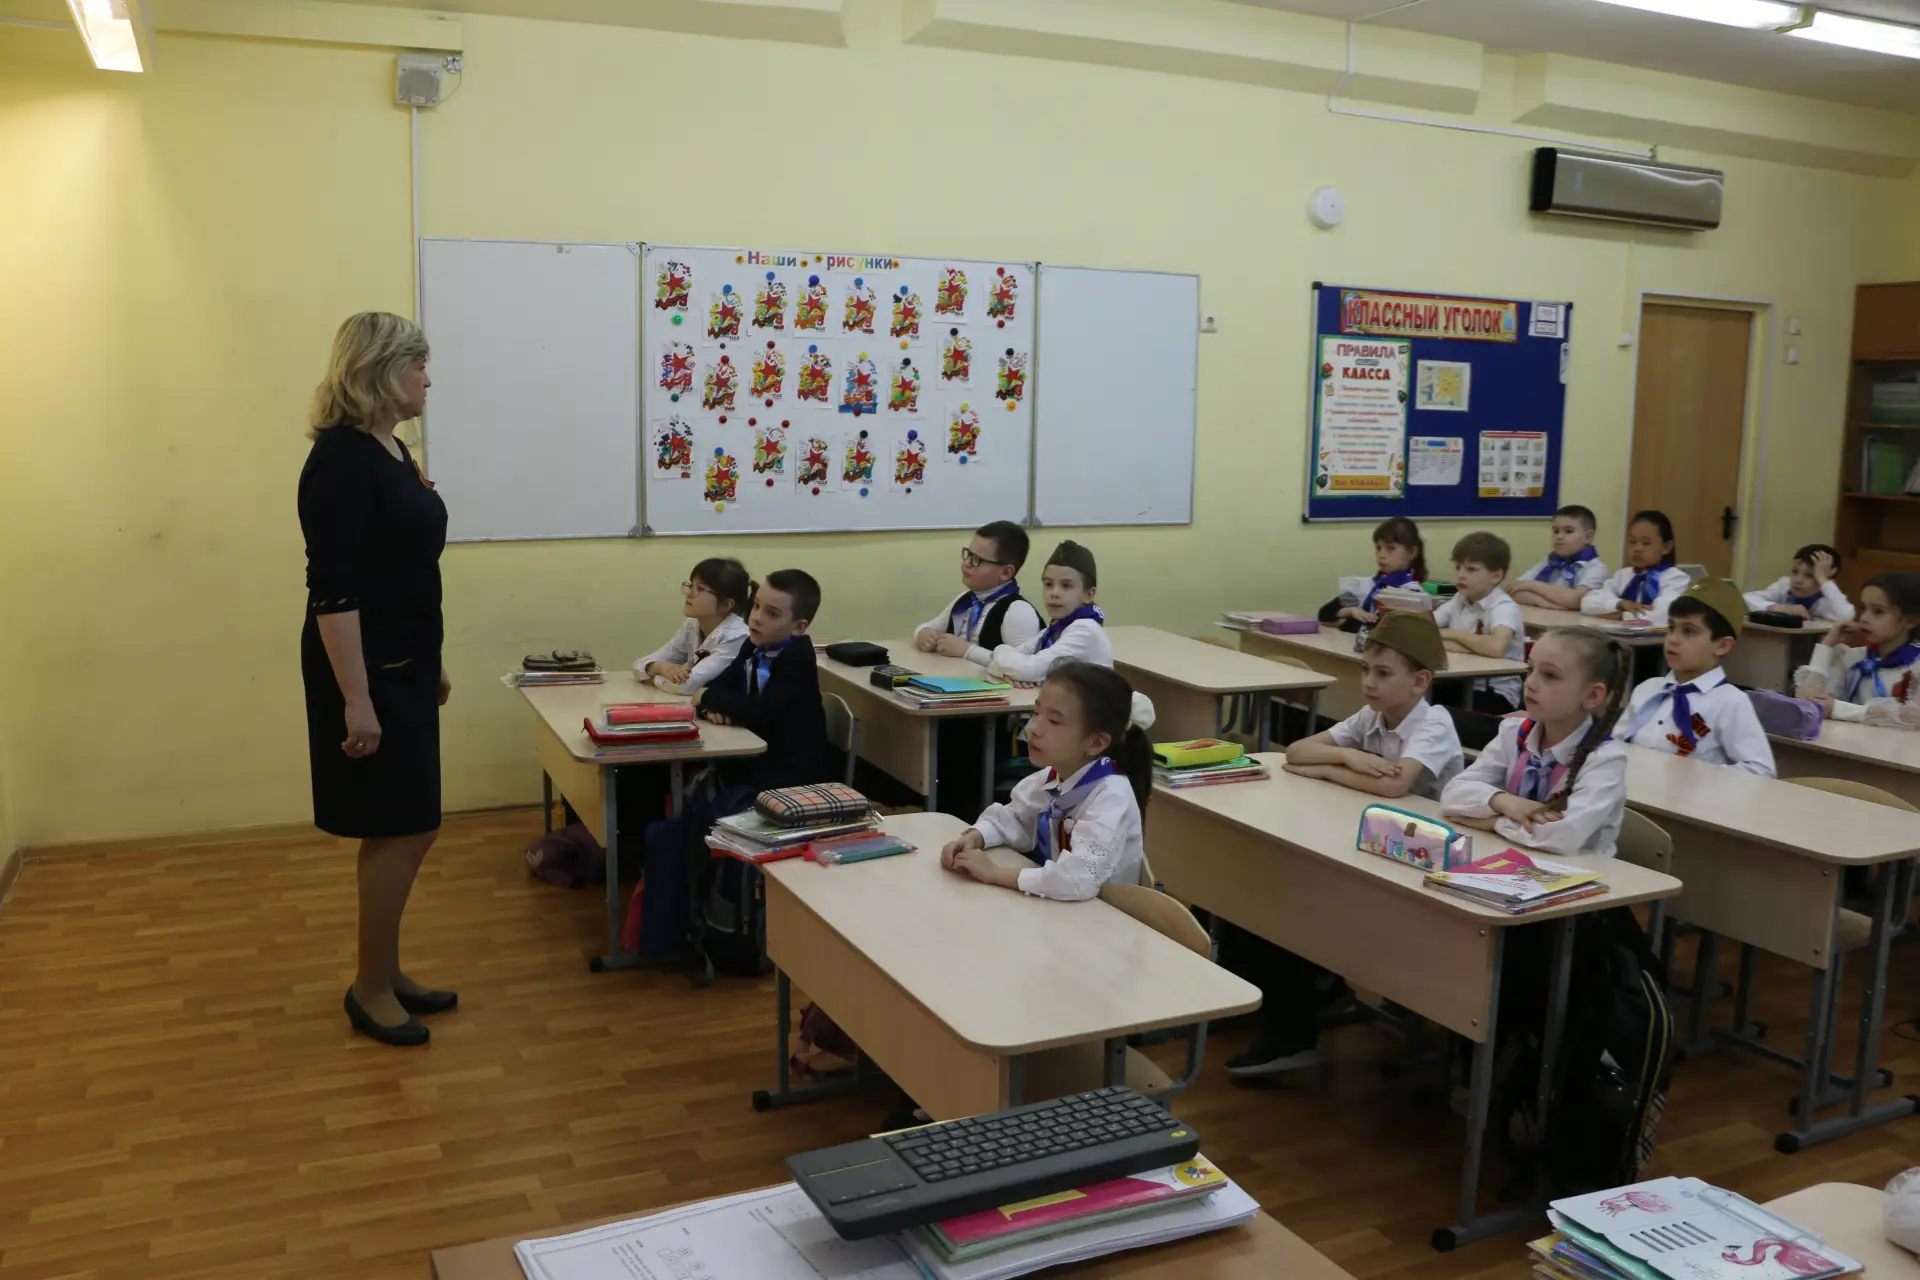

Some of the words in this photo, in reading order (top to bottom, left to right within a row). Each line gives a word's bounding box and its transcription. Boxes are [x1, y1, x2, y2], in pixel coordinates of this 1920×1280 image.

[747, 251, 797, 267] Наши
[826, 255, 893, 272] рисунки
[1347, 298, 1440, 331] КЛАССНЫЙ
[1443, 305, 1503, 335] УГОЛОК
[1336, 343, 1397, 359] ПРАВИЛА
[1342, 367, 1391, 380] КЛАССА
